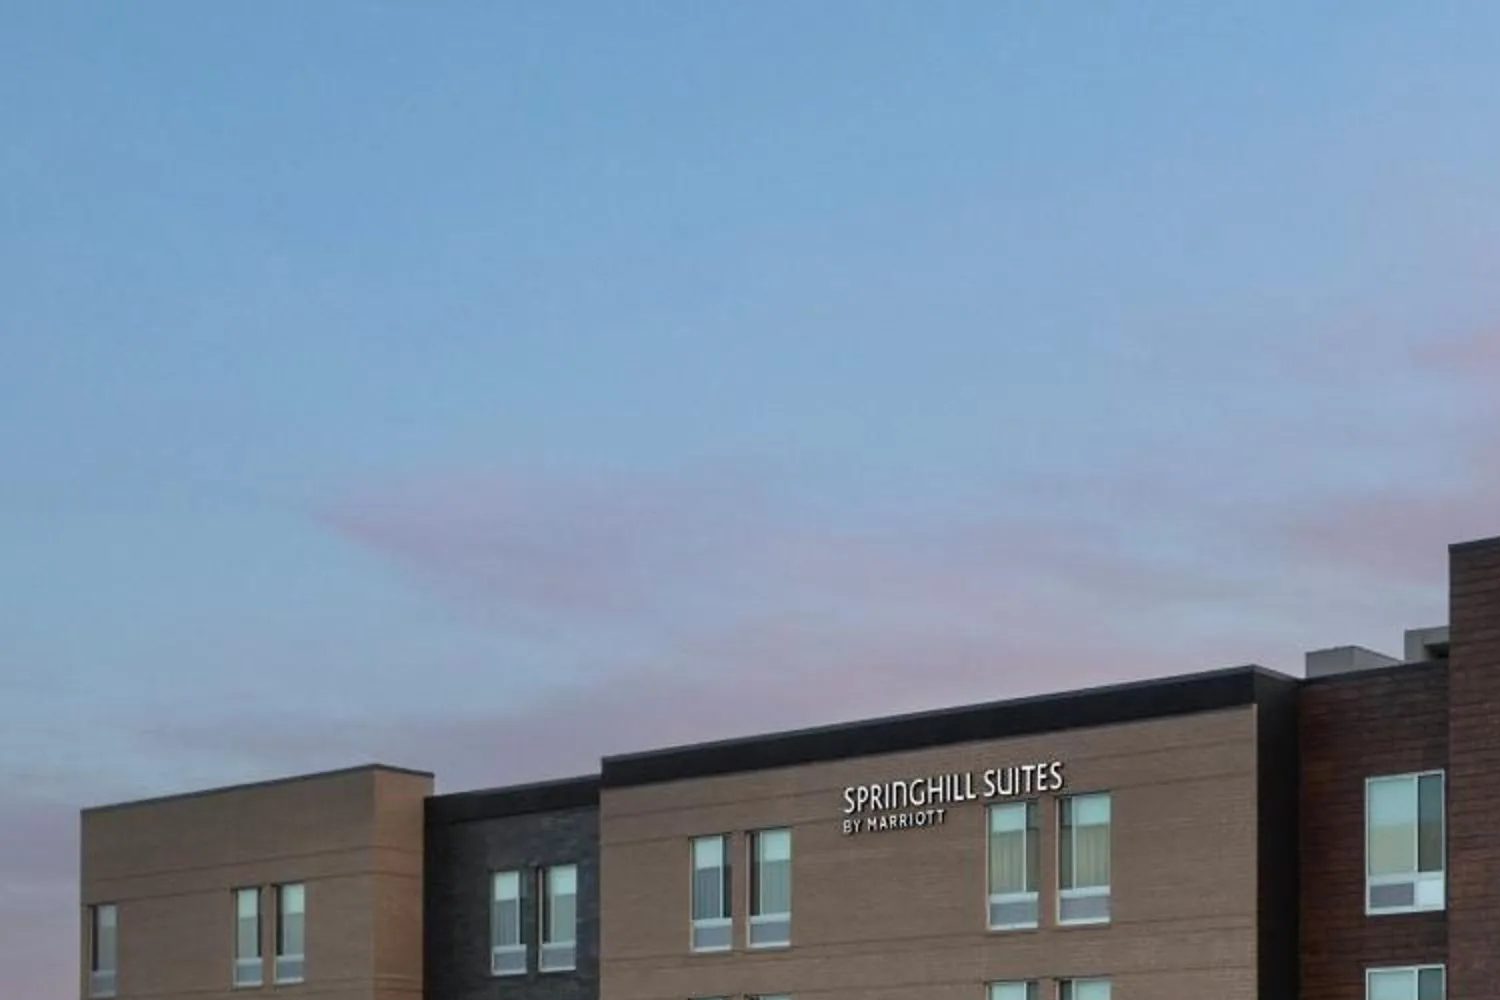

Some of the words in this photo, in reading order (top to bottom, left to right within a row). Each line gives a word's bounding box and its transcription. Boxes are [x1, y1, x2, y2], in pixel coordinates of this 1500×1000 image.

[843, 772, 977, 814] SPRINGHILL
[983, 761, 1063, 797] SUITES
[843, 818, 861, 833] BY
[867, 809, 945, 830] MARRIOTT
